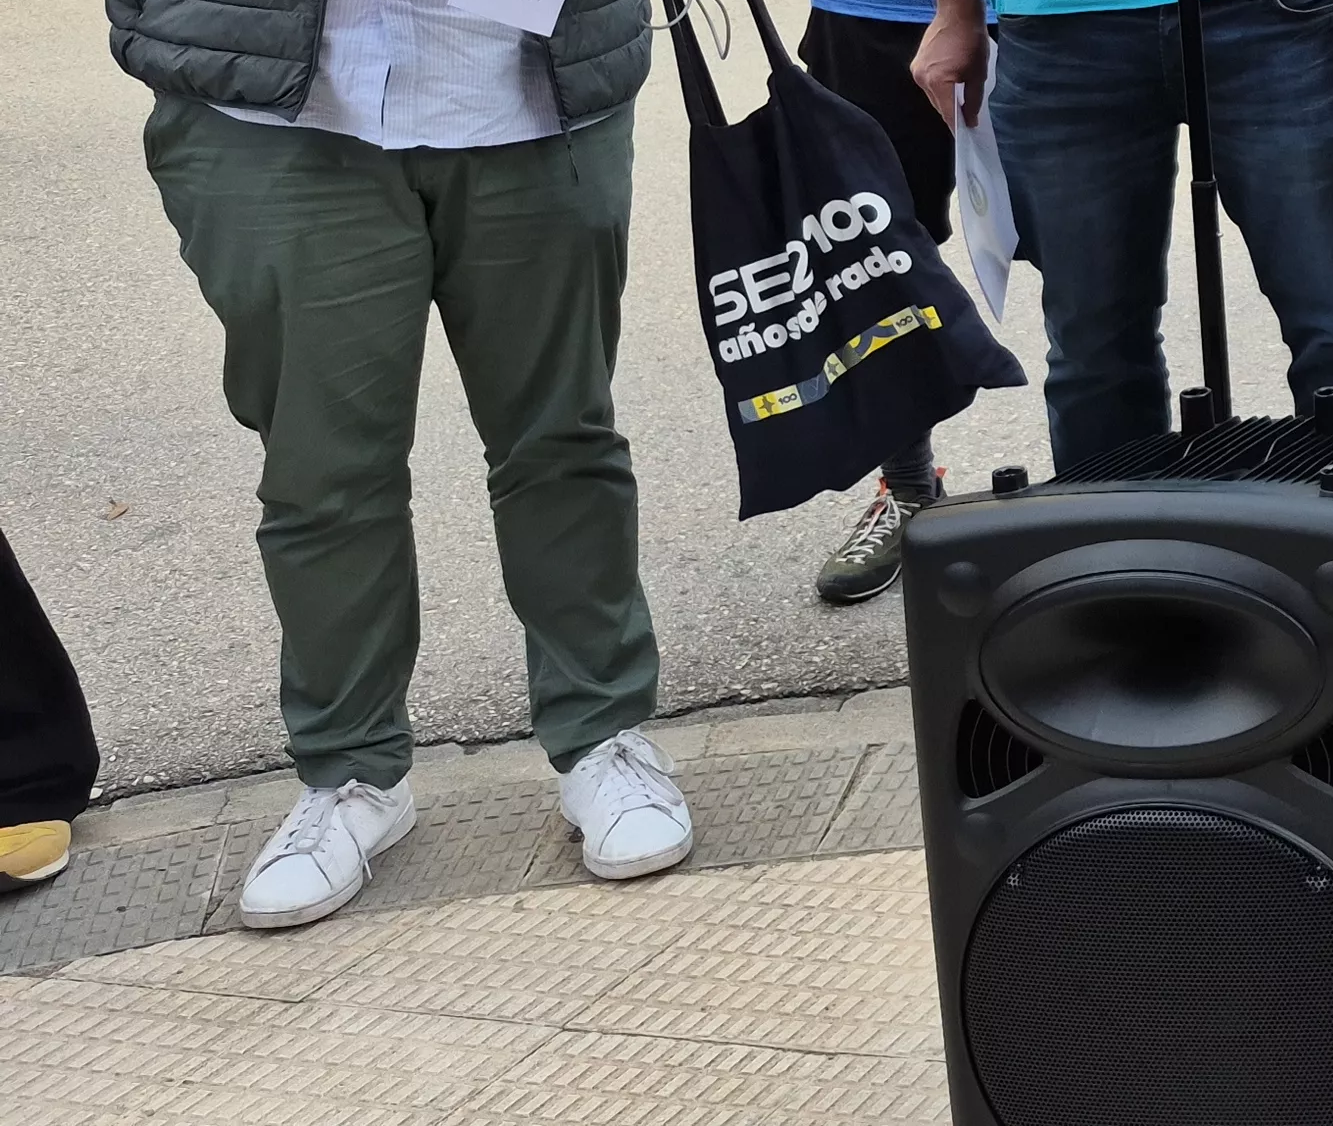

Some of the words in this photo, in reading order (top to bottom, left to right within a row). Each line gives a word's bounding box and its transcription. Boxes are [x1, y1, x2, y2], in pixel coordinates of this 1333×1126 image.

[803, 192, 891, 253] 100
[896, 315, 913, 327] 100
[778, 392, 798, 405] 100
